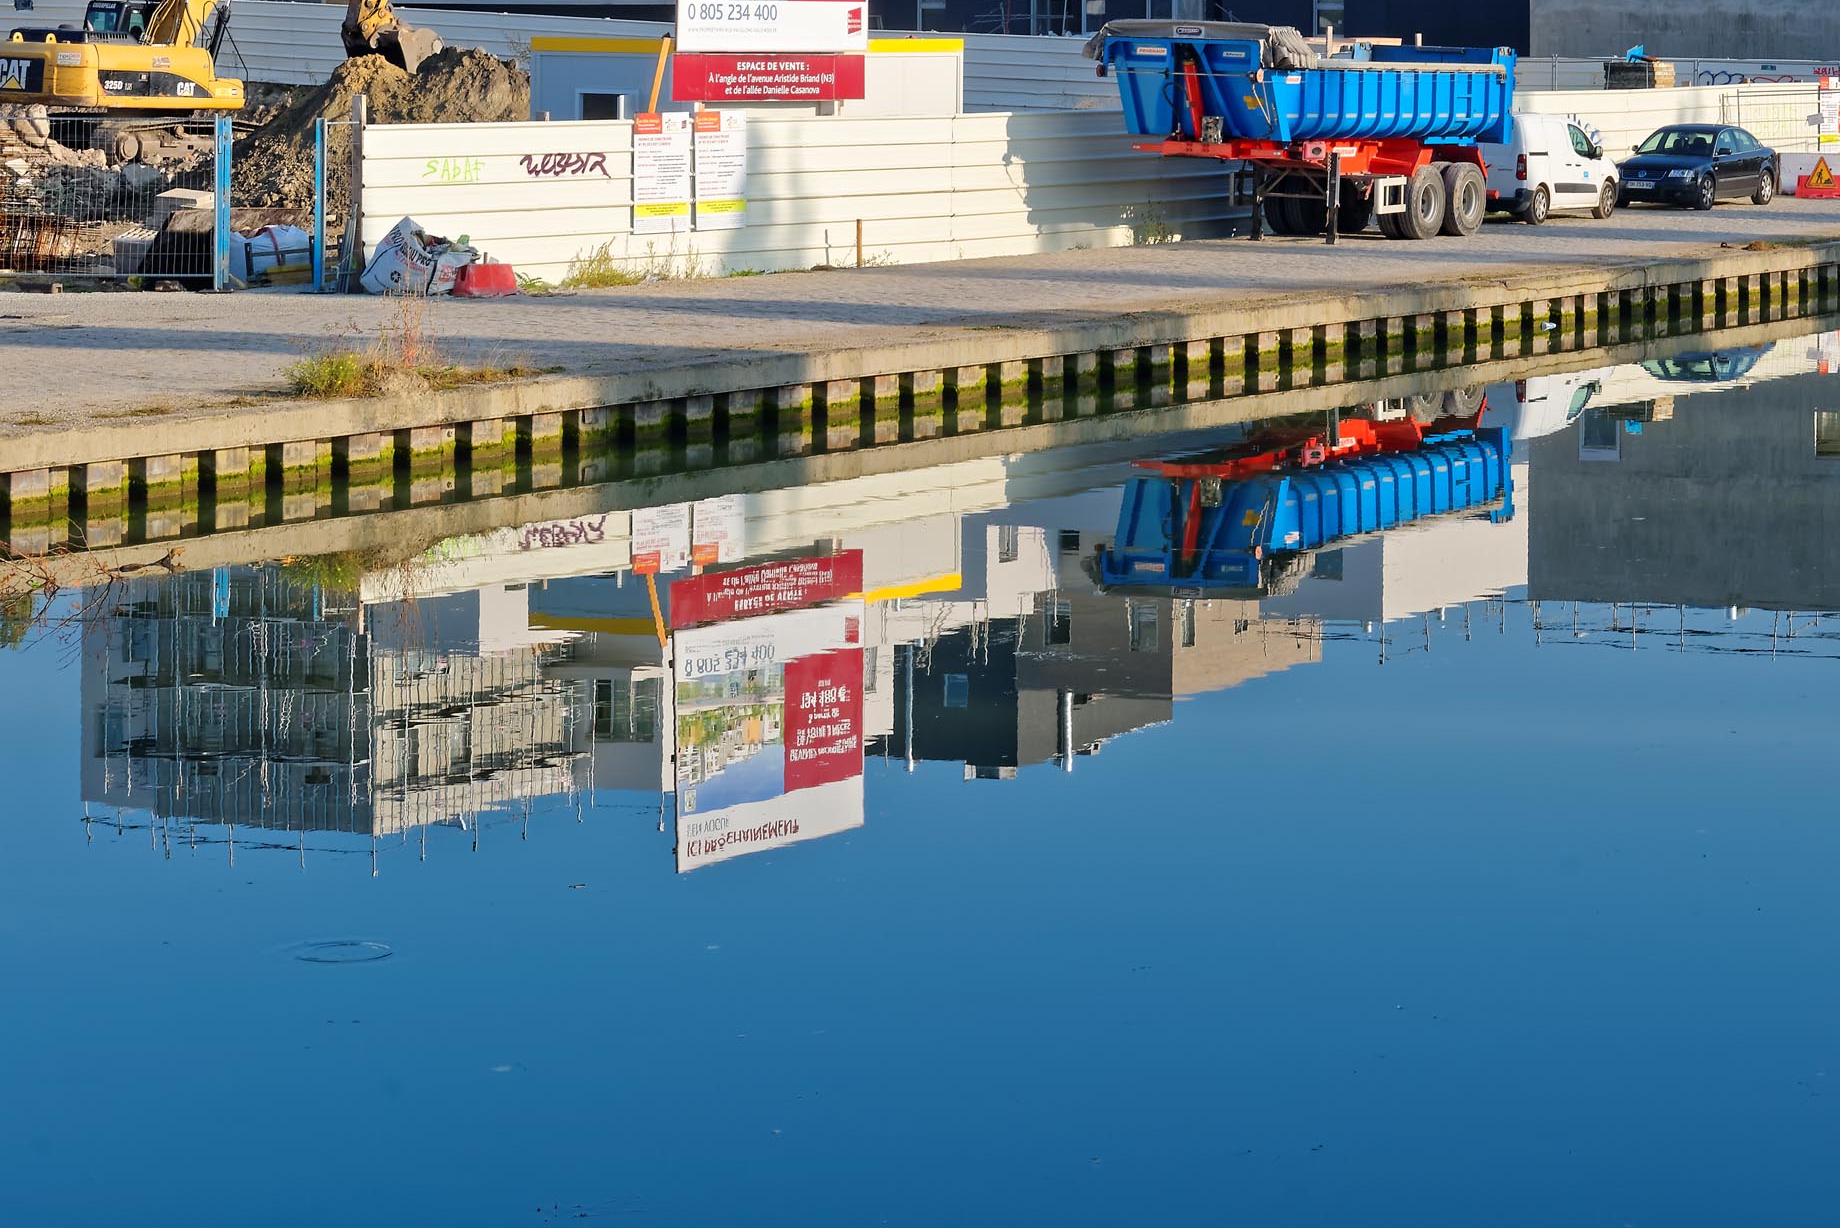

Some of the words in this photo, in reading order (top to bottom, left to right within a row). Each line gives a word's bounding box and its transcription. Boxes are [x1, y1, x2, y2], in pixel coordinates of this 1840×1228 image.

[688, 3, 696, 20] 0
[700, 3, 723, 20] 805
[727, 4, 750, 21] 234
[754, 4, 777, 21] 400
[737, 61, 766, 71] ESPACE
[767, 61, 777, 71] DE
[779, 61, 805, 71] VENTE
[0, 59, 31, 90] CAT
[708, 72, 714, 83] À
[715, 73, 737, 85] l'angle
[738, 74, 747, 83] de
[748, 74, 773, 83] l'avenue
[774, 74, 799, 83] Aristide
[800, 74, 820, 83] Briand
[821, 72, 835, 85] (N3)
[104, 80, 124, 90] 325D
[176, 81, 196, 96] CAT
[725, 86, 732, 95] et
[733, 85, 742, 95] de
[743, 85, 762, 95] l'allée
[763, 85, 789, 95] Danielle
[790, 85, 820, 95] Casanova
